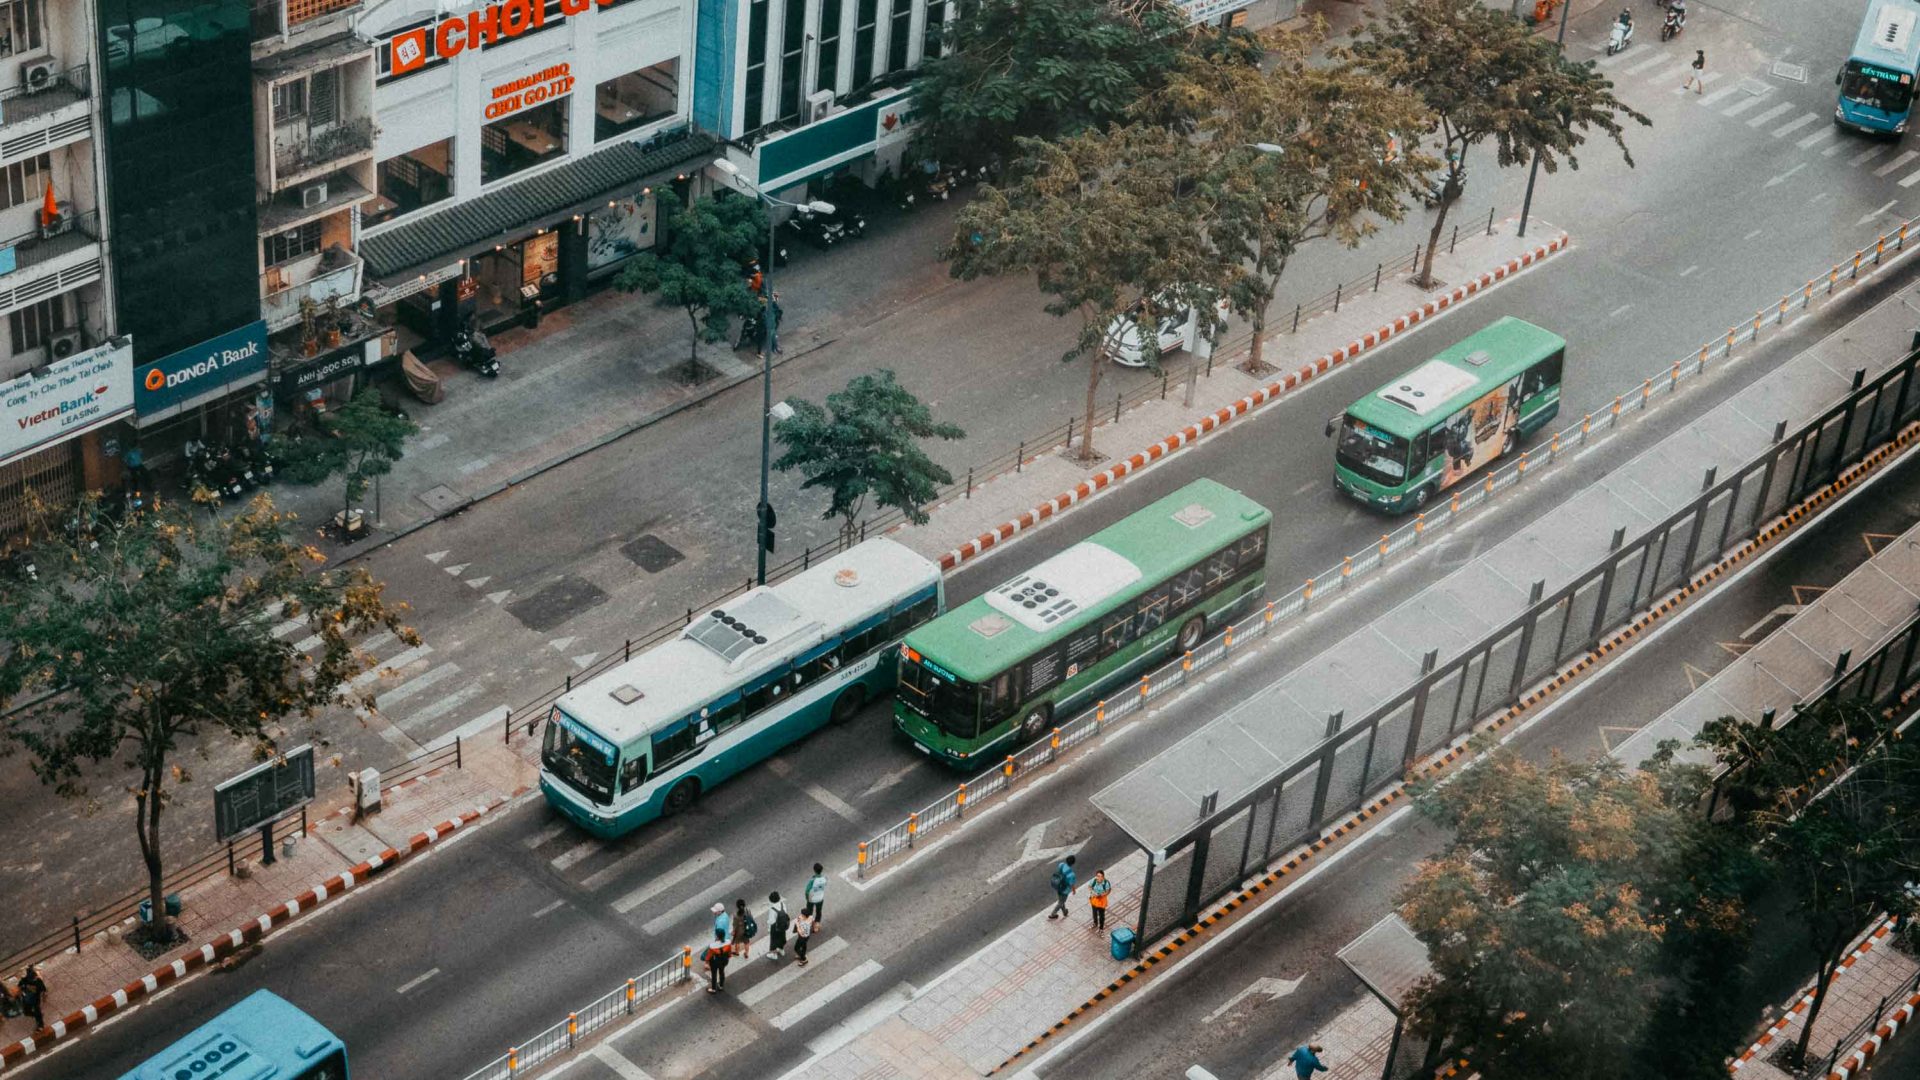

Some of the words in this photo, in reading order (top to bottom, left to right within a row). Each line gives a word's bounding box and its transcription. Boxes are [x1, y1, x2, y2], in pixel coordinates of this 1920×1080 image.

[436, 0, 545, 58] CHOI
[485, 94, 522, 119] CHOI
[524, 86, 548, 105] GO
[548, 76, 575, 97] JIP
[221, 341, 259, 367] Bank
[18, 391, 94, 430] VietinBank
[61, 405, 100, 426] LEASING
